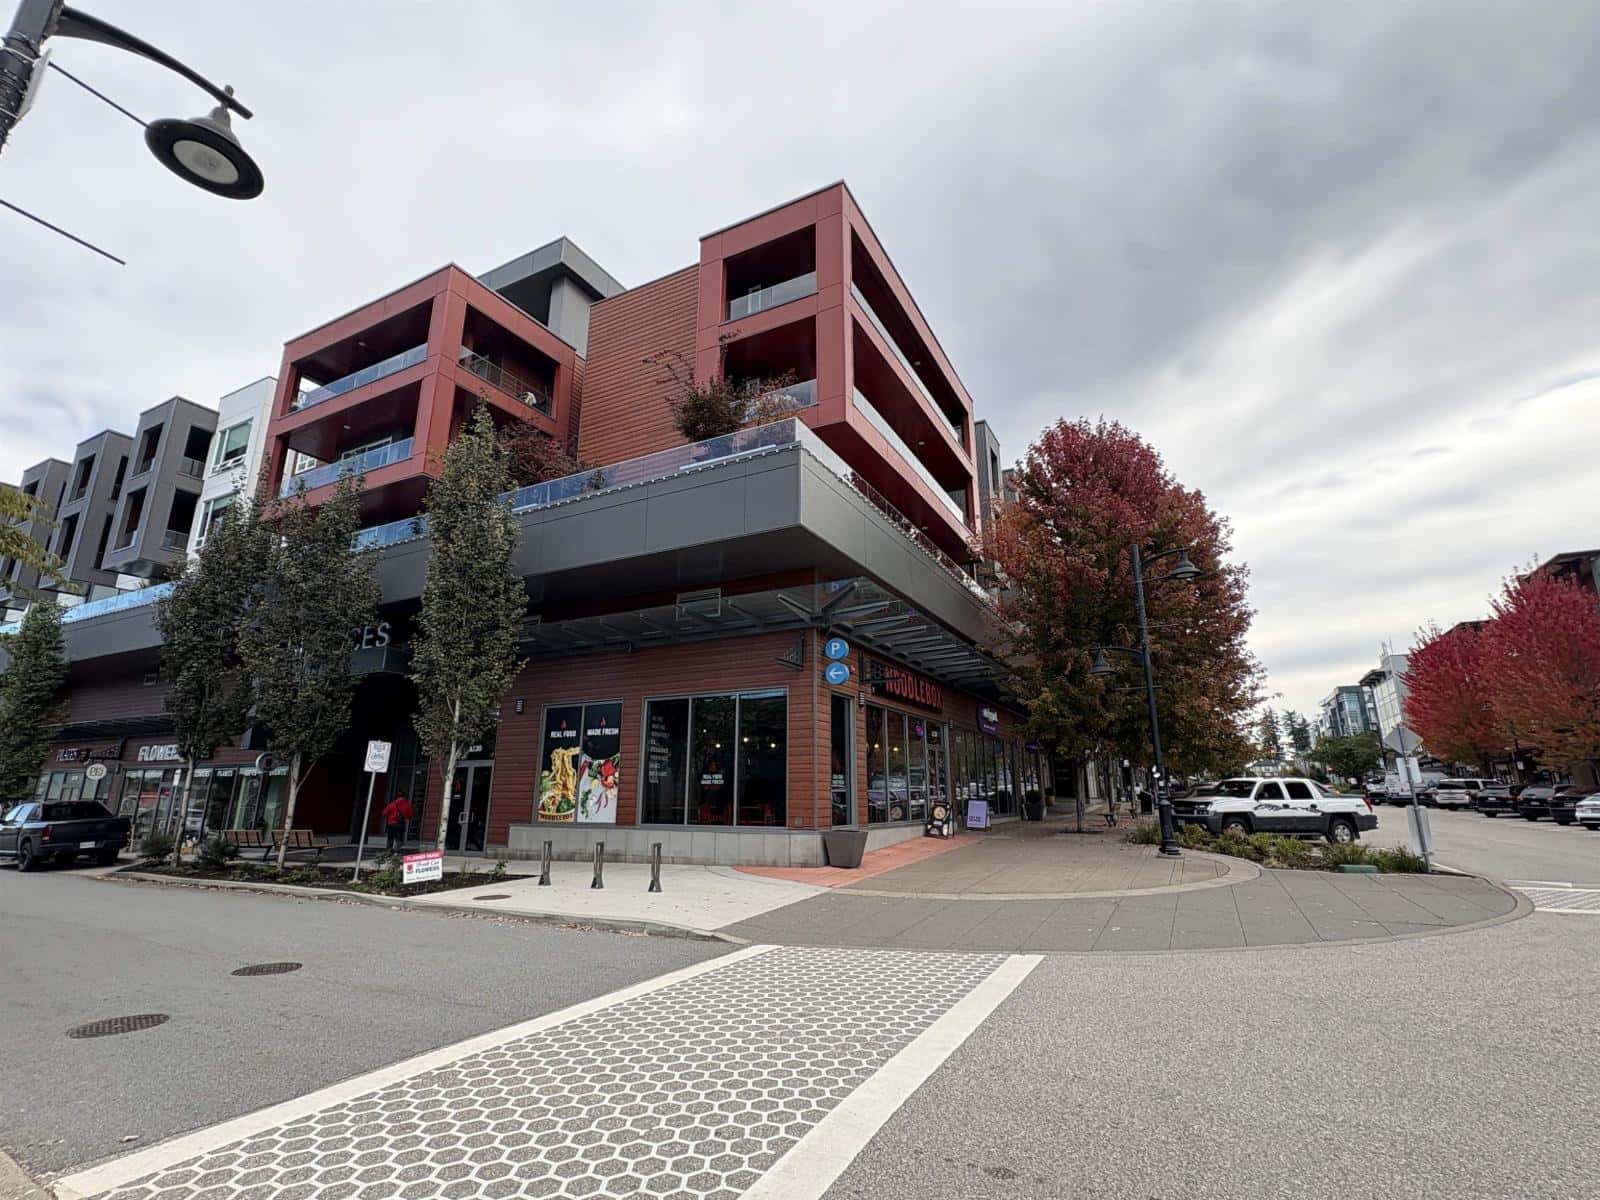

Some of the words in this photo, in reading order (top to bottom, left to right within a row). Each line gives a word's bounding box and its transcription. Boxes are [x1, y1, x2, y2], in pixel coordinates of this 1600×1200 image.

[831, 642, 841, 655] P
[551, 730, 562, 738] REAL
[587, 728, 601, 736] MADE
[602, 728, 619, 736] FRESH
